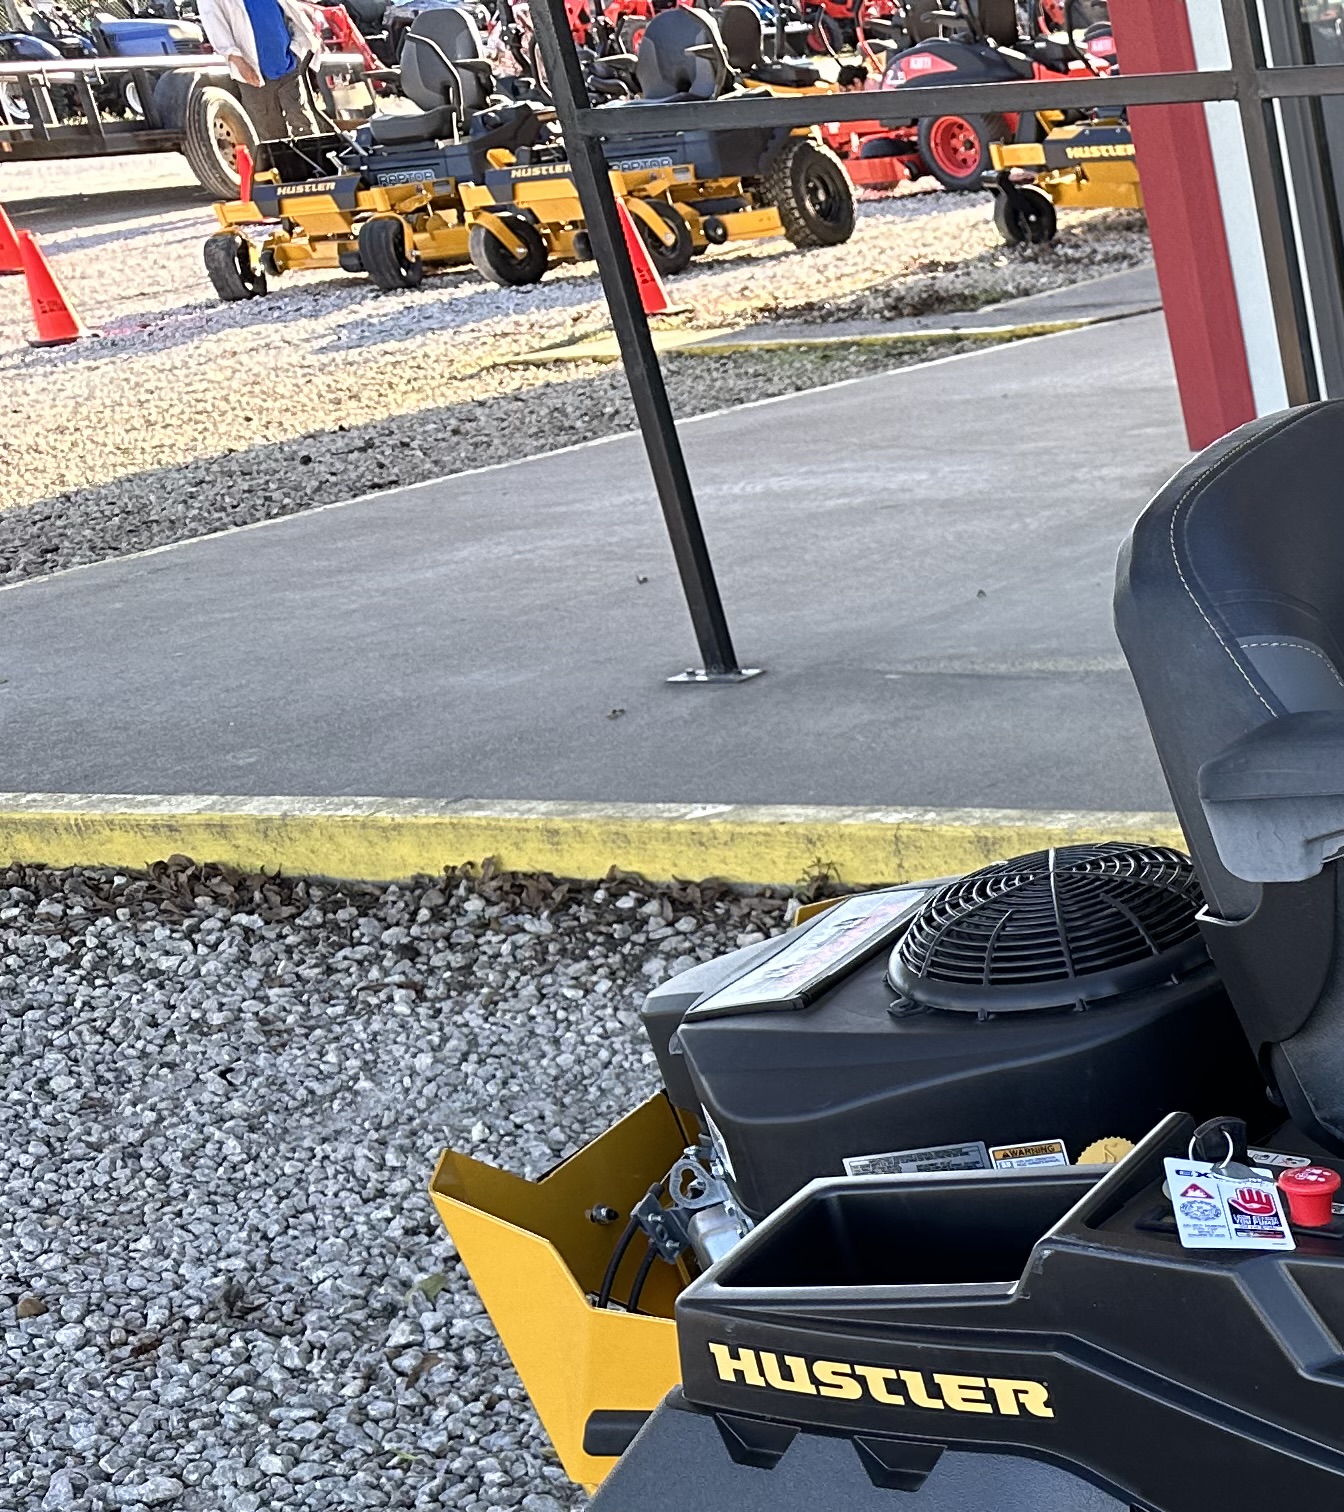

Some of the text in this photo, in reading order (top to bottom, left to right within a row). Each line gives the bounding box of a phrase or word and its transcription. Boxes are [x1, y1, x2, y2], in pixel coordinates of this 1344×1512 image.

[377, 169, 436, 187] RAPTOR
[277, 182, 336, 196] HUSTLER
[1010, 1144, 1055, 1158] WARNING
[708, 1341, 1055, 1419] HUSTLER
